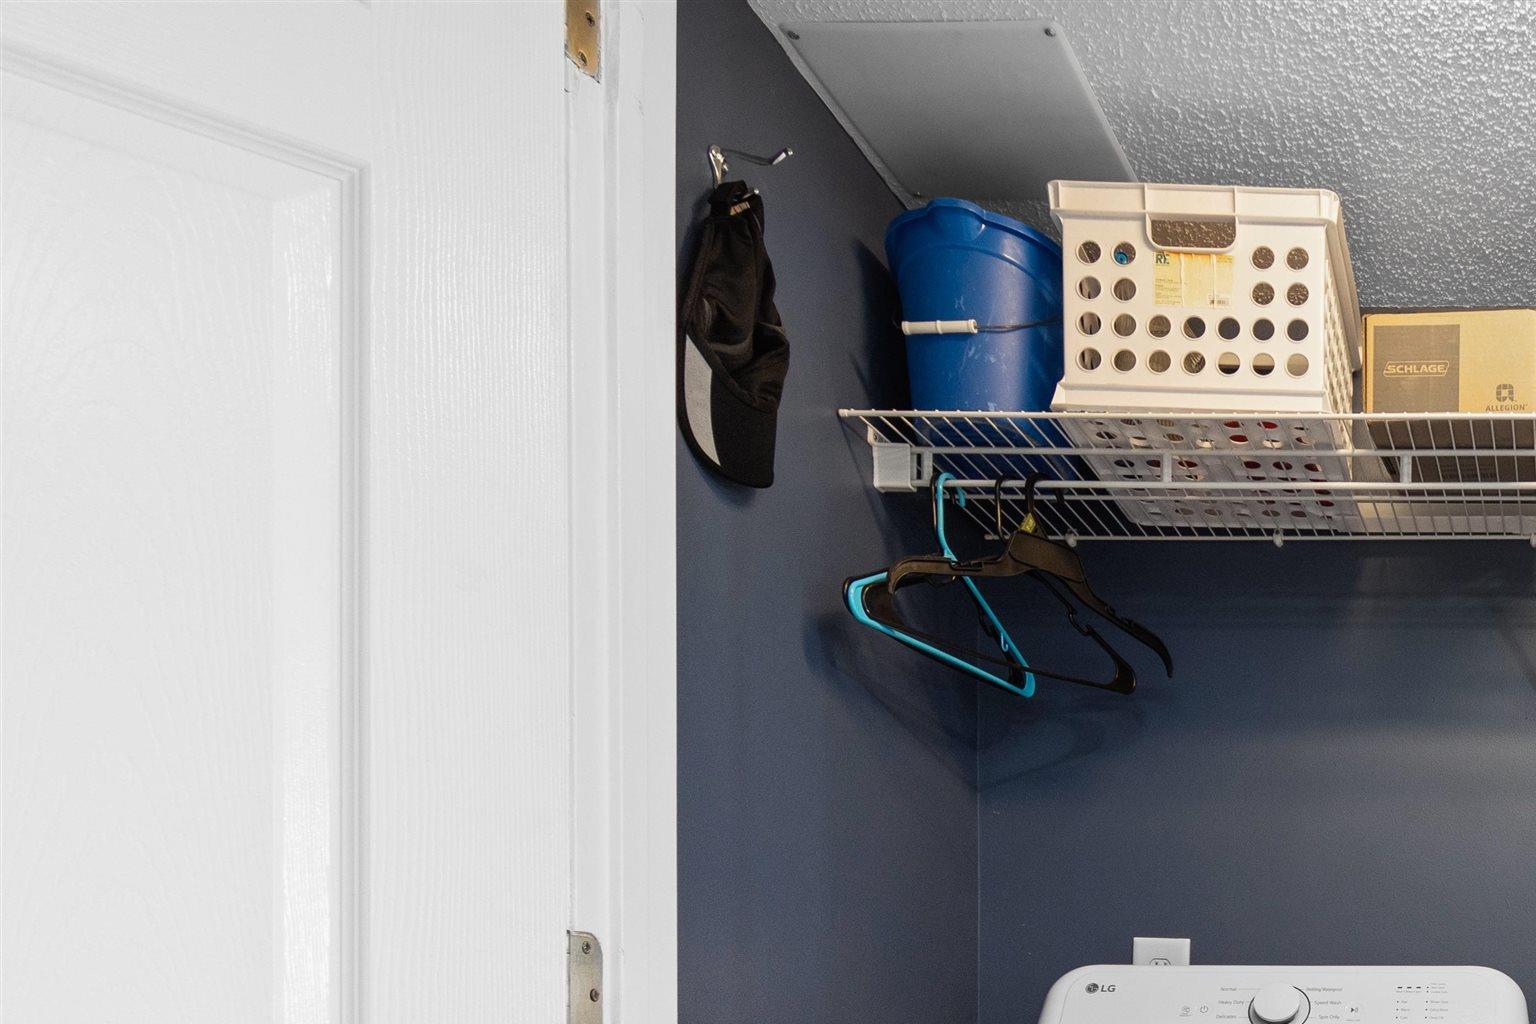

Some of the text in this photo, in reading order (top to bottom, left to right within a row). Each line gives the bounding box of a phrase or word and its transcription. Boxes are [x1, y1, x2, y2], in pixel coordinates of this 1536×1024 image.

[1386, 364, 1446, 374] SCHLAGE
[1485, 403, 1525, 412] ALLEGION
[1101, 984, 1116, 993] LG
